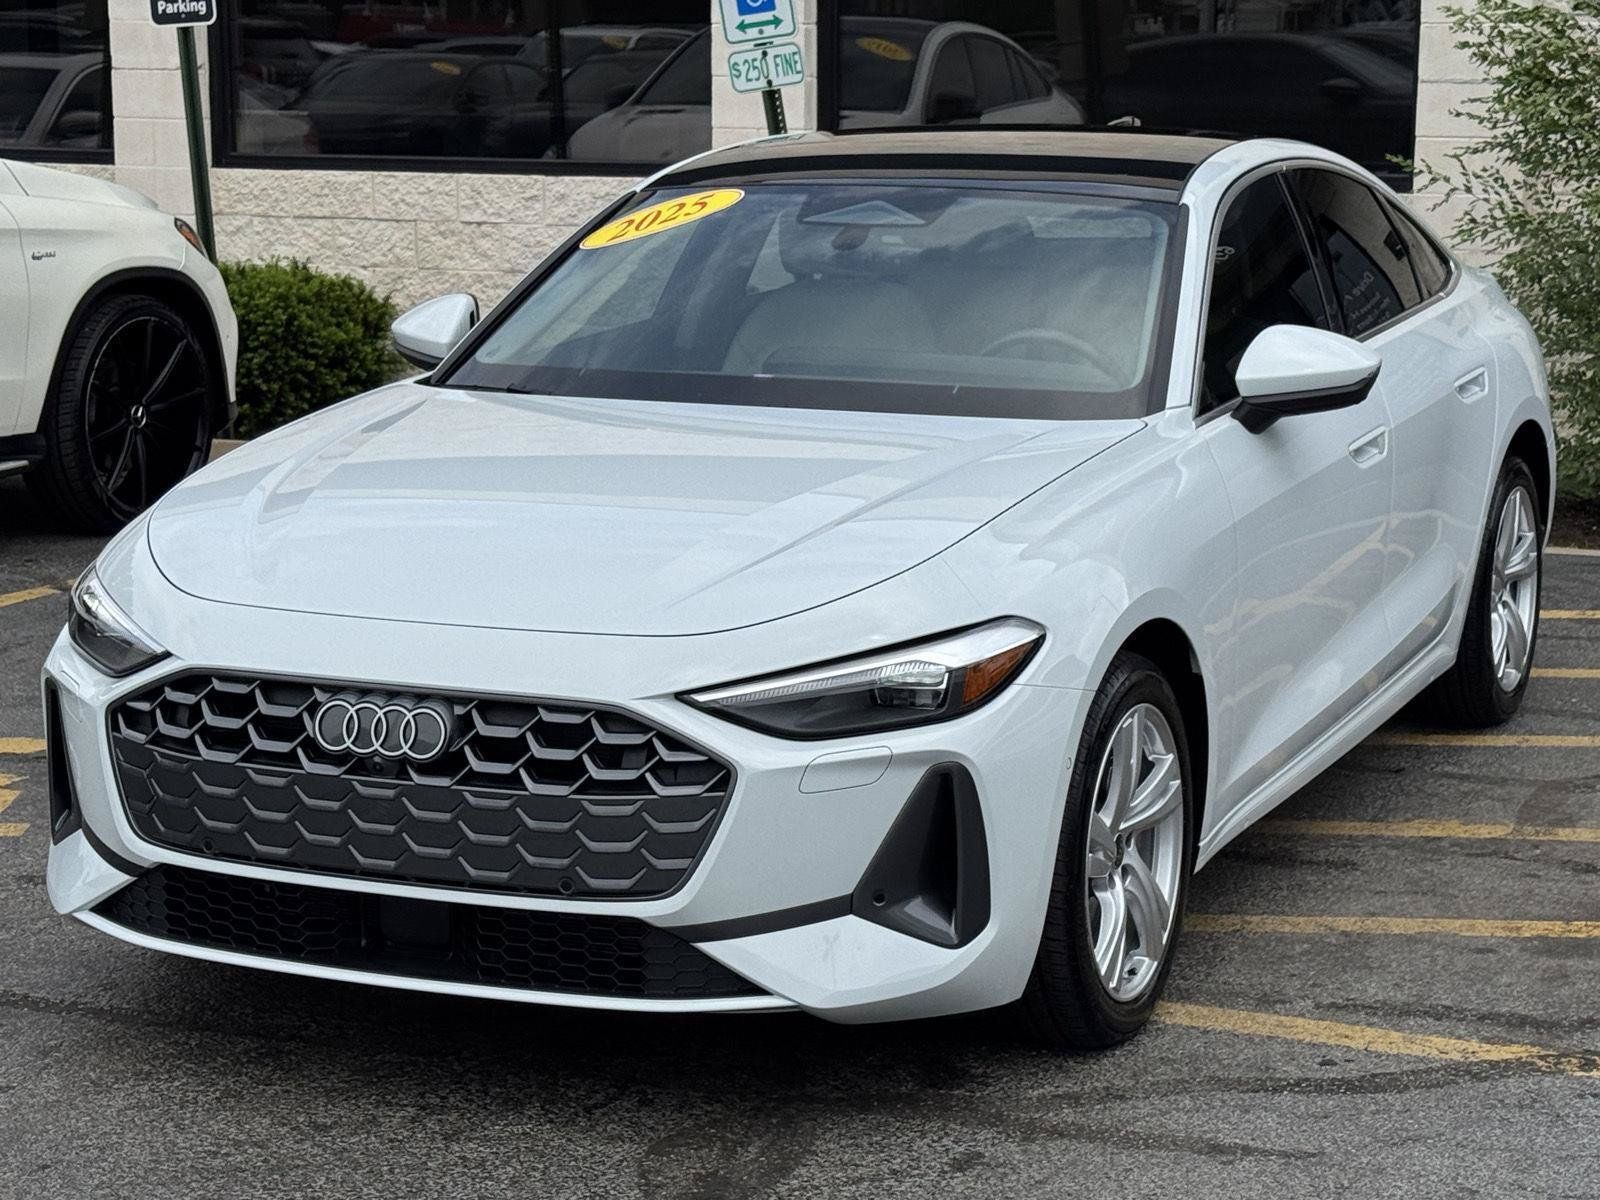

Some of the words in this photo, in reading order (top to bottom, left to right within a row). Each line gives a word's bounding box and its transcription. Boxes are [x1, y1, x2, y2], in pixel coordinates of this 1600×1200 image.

[157, 0, 207, 15] Parking
[773, 51, 803, 78] FINE
[606, 193, 715, 243] 2025
